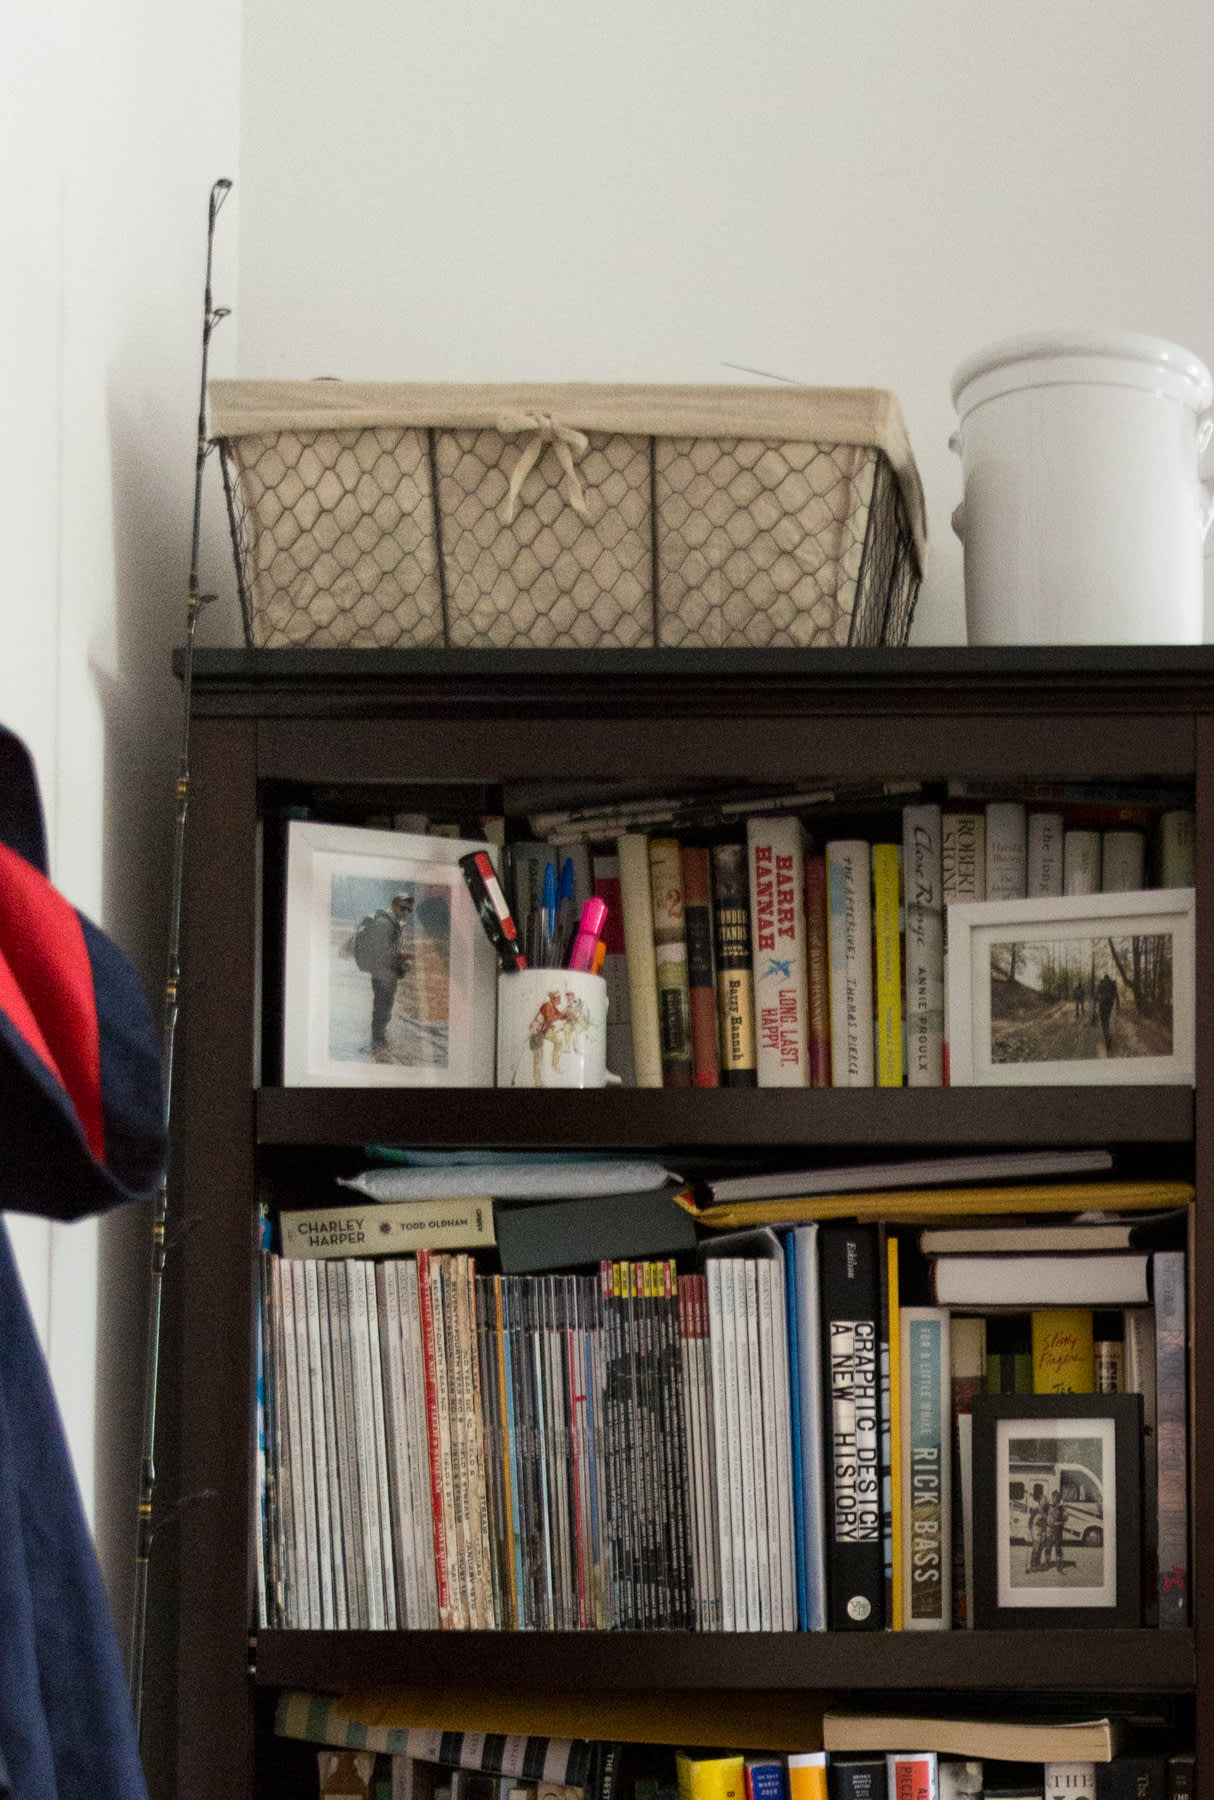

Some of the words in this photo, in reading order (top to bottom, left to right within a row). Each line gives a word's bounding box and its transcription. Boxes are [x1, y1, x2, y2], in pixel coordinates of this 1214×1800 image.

[914, 827, 932, 881] Close
[957, 819, 977, 895] ROBERT
[755, 845, 776, 952] HANNAH
[776, 855, 795, 940] BARRY
[729, 980, 741, 1011] Barry
[846, 978, 857, 1028] THOMAS
[918, 968, 928, 1009] ANNIE
[731, 1016, 744, 1062] Hannah
[761, 1008, 779, 1049] HAPPY
[918, 1017, 929, 1071] PROULX
[848, 1035, 858, 1075] PIERCE
[298, 1219, 364, 1235] CHARLEY
[310, 1233, 365, 1247] HARPER
[400, 1222, 426, 1231] TODD
[429, 1218, 468, 1229] OLDHAM
[832, 1324, 853, 1336] A
[833, 1353, 854, 1402] NEW
[854, 1322, 876, 1432] GRAPHIC
[834, 1433, 858, 1541] HISTORY
[857, 1448, 878, 1540] DESIGN
[912, 1448, 938, 1505] RICK
[913, 1520, 939, 1582] BASS
[604, 1752, 615, 1773] THE
[1046, 1775, 1097, 1787] THE
[1136, 1775, 1149, 1796] The
[602, 1776, 613, 1800] BEST
